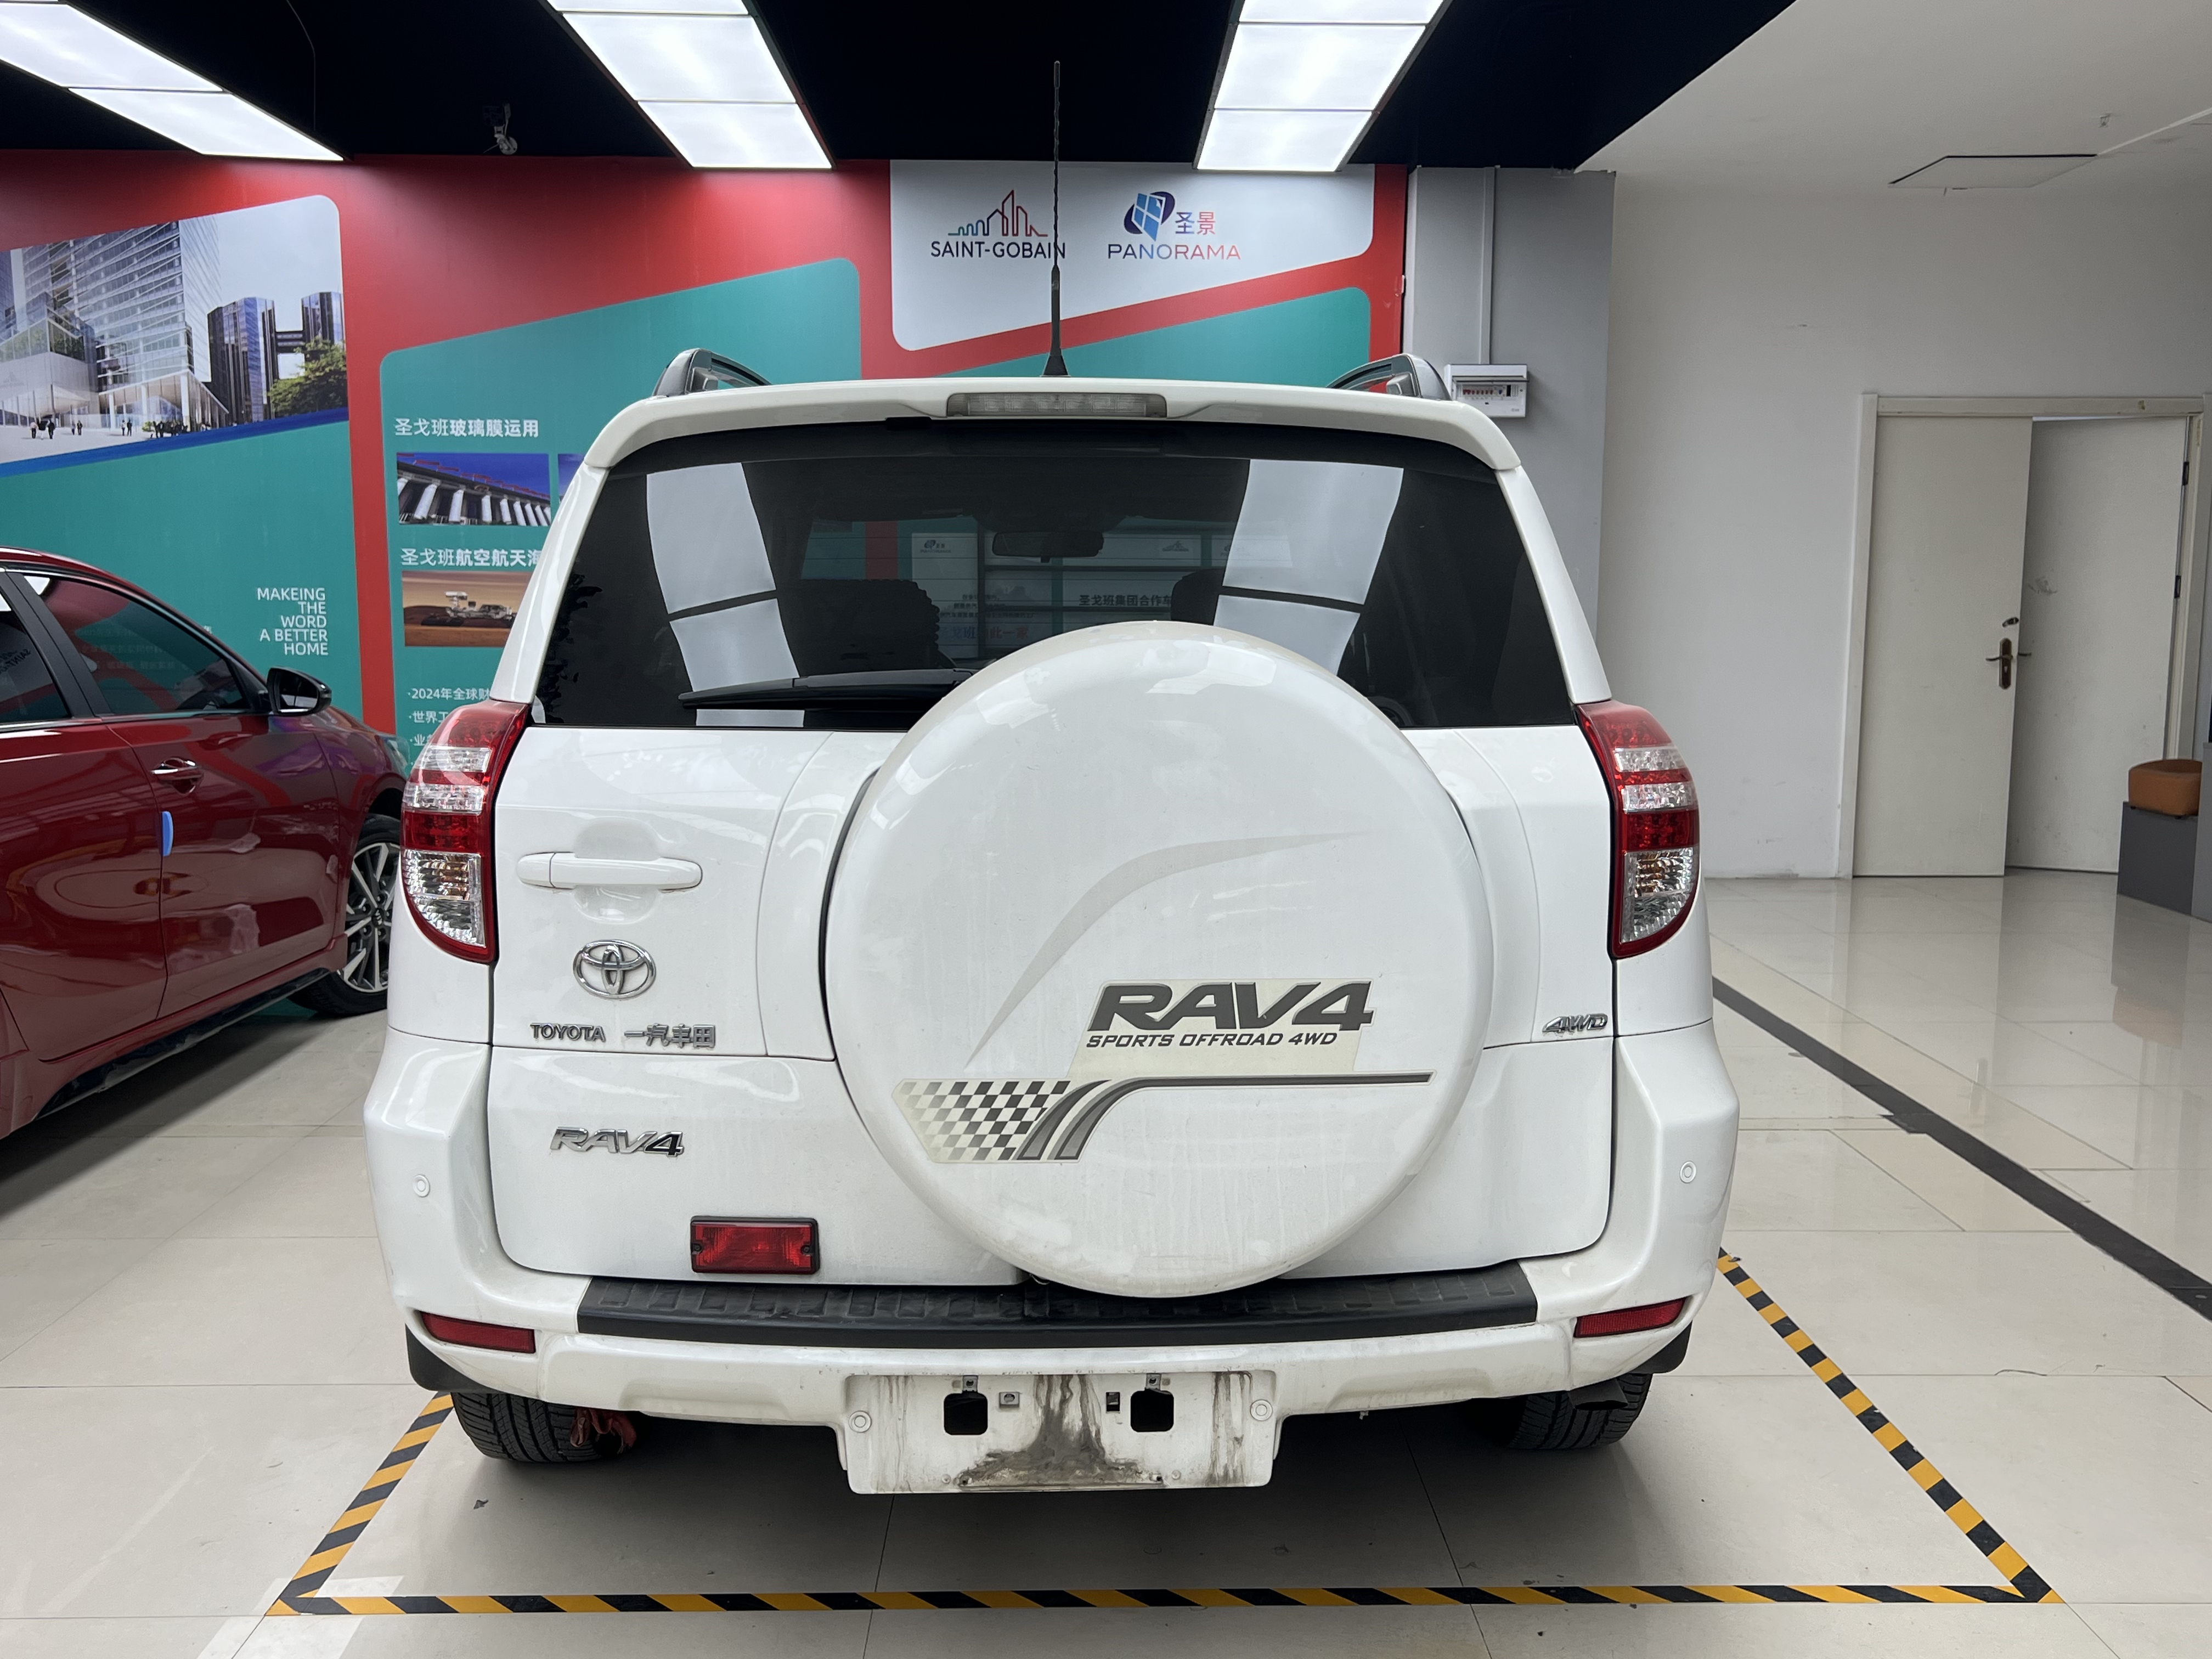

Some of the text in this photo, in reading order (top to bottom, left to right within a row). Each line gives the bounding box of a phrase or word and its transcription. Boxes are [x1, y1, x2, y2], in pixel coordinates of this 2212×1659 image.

[1175, 211, 1216, 236] 圣景
[930, 240, 1066, 259] SAINT-GOBAIN
[1108, 243, 1242, 260] PANORAMA
[394, 417, 539, 437] 圣戈班玻璃膜运用
[257, 587, 326, 601] MAKEING
[297, 601, 327, 614] THE
[280, 614, 327, 628] WORD
[259, 628, 328, 642] A BETTER
[284, 642, 329, 656] HOME
[1087, 981, 1374, 1031] RAV4
[1542, 1013, 1609, 1032] 4WD
[530, 1022, 606, 1043] TOYOTA
[624, 1023, 715, 1048] 一汽丰田
[1086, 1032, 1338, 1048] SPORTS OFFROAD 4WD
[550, 1126, 685, 1157] RAV4
